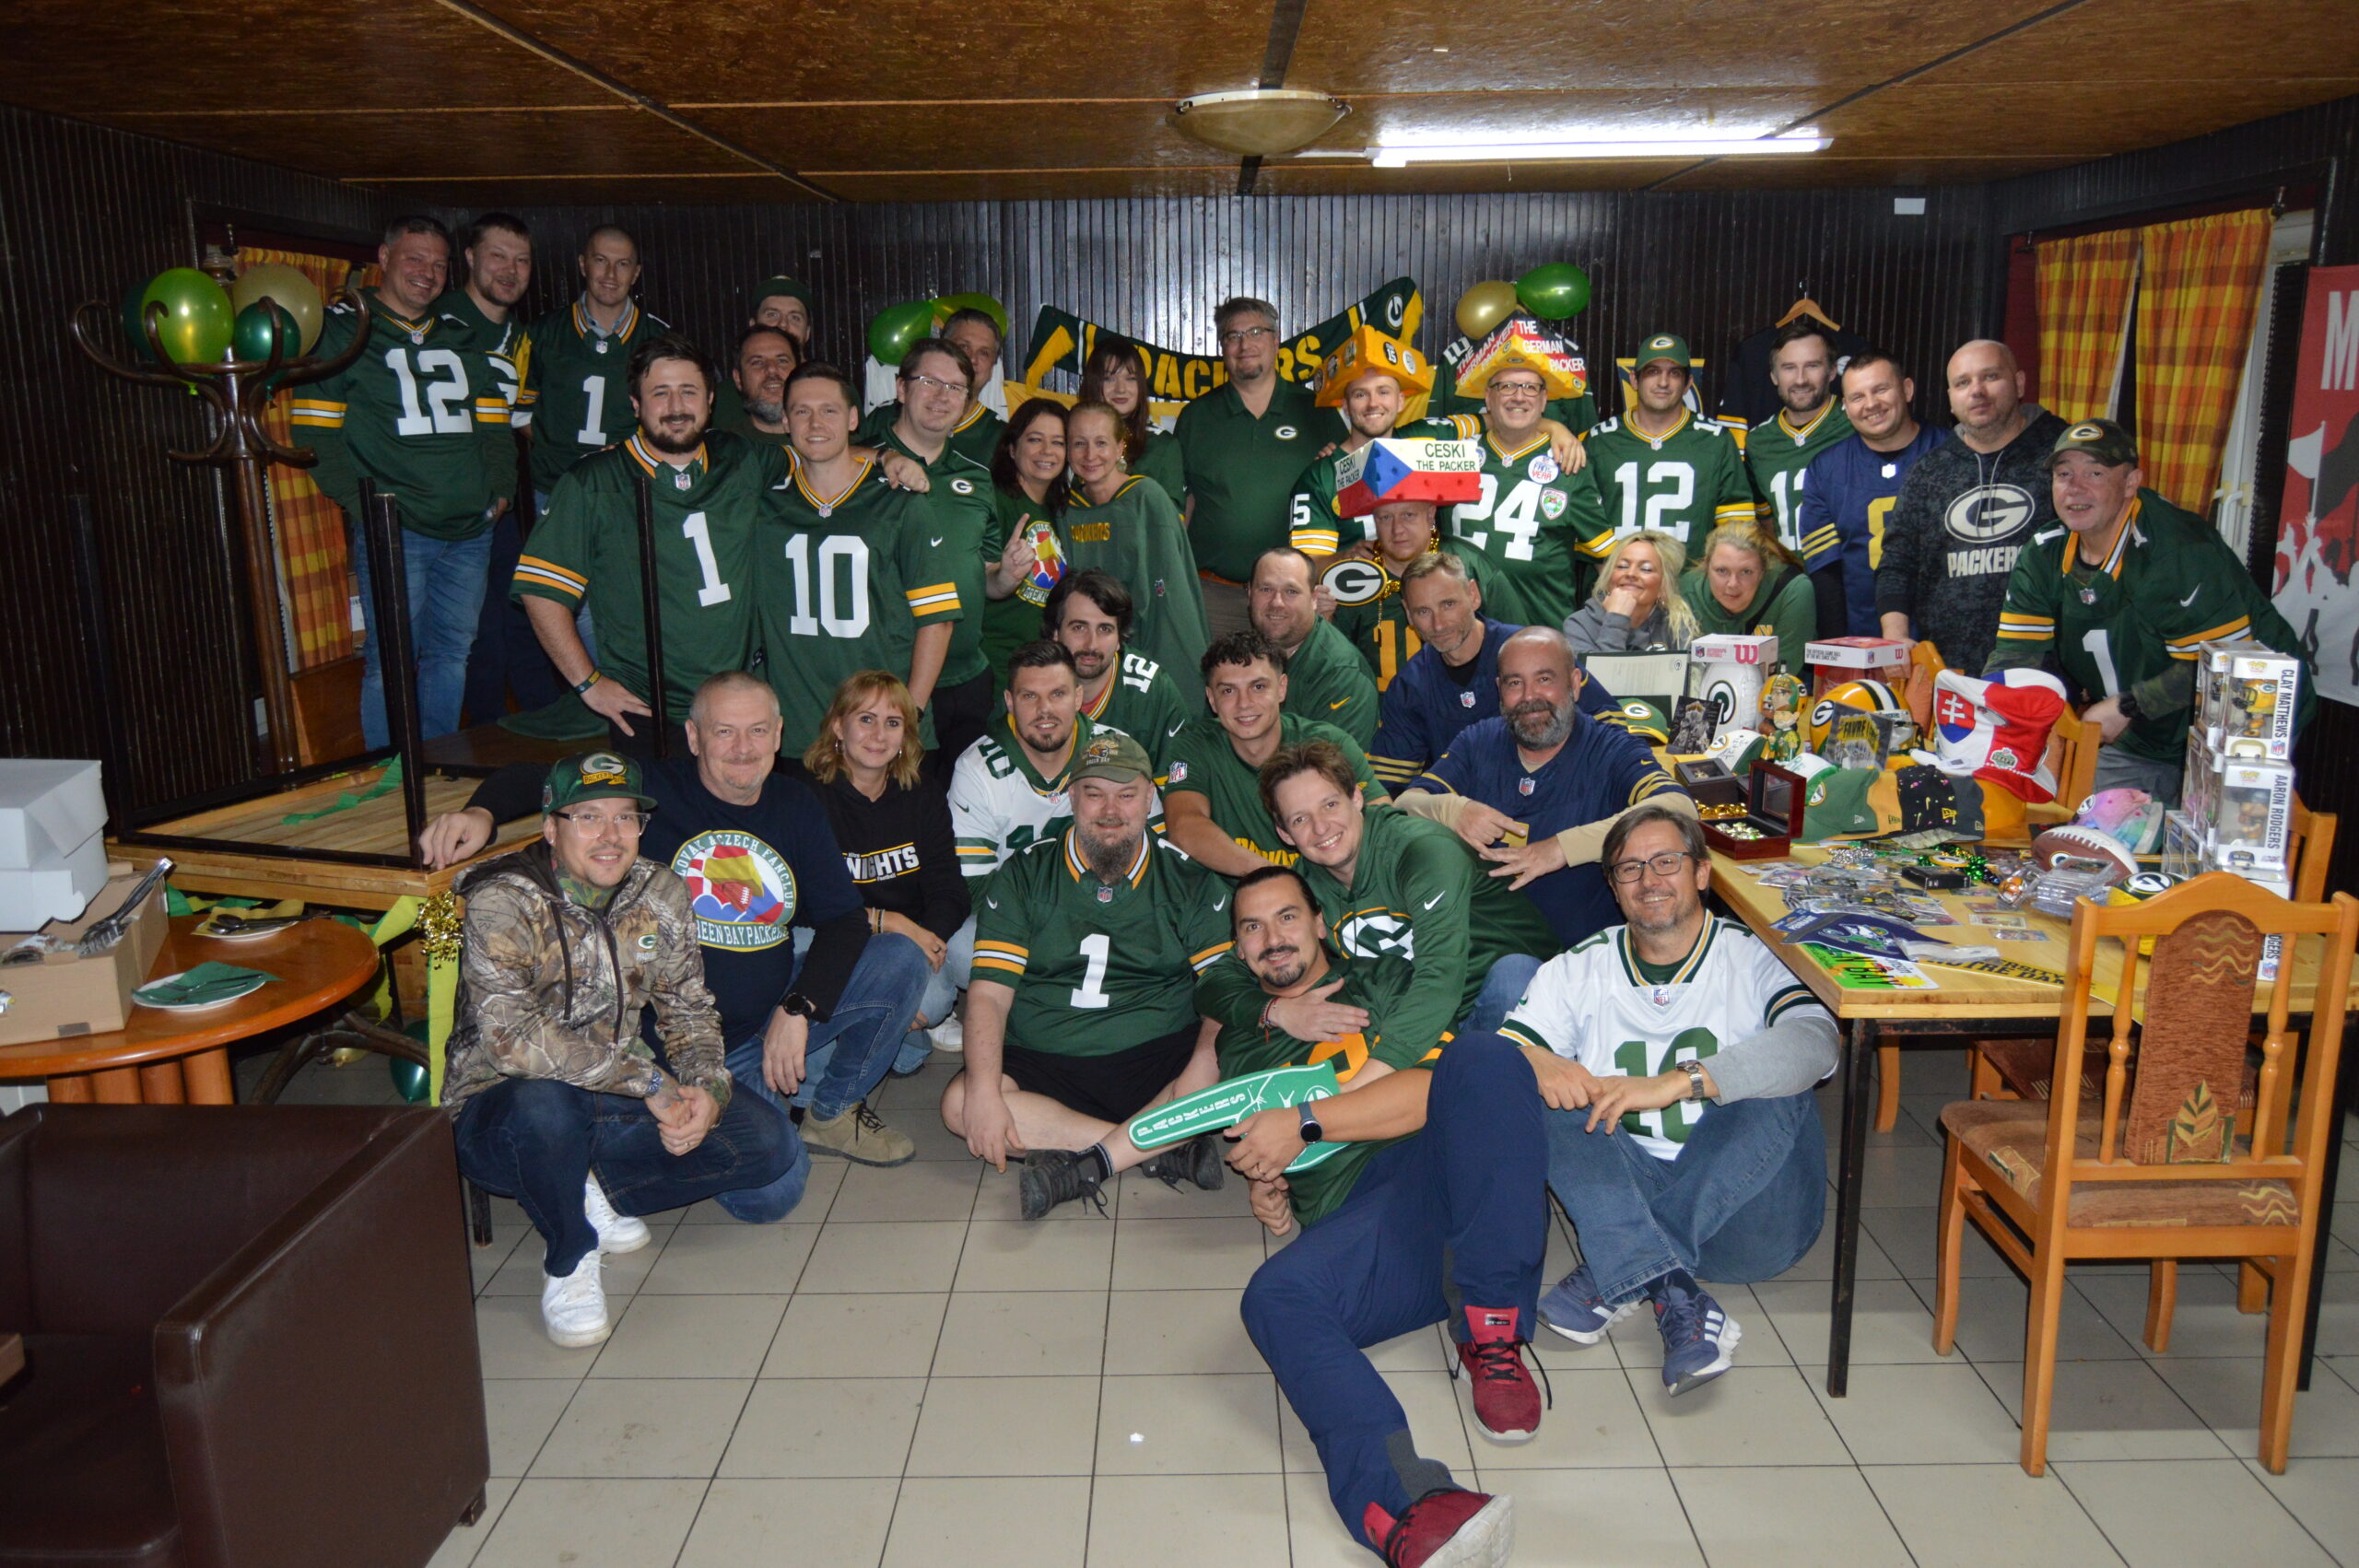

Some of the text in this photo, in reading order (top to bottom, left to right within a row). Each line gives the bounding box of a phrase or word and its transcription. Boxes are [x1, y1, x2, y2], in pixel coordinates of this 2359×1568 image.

[1481, 319, 1514, 371] PACKER
[1516, 320, 1538, 334] THE
[1522, 340, 1564, 354] GERMAN
[1549, 357, 1586, 373] PACKER
[385, 348, 473, 436] 12
[578, 375, 606, 445] 1
[1275, 426, 1297, 439] G
[1425, 443, 1465, 458] CESKI
[1339, 454, 1356, 474] CESKI
[1345, 469, 1360, 485] PACKER
[1416, 460, 1476, 472] THE PACKER
[951, 479, 973, 495] G
[1614, 462, 1695, 544] 12
[1291, 493, 1310, 525] 5
[1451, 473, 1543, 561] 24
[1946, 485, 2033, 541] G
[683, 511, 732, 607] 1
[785, 533, 870, 638] 10
[1322, 560, 1381, 604] G
[1123, 653, 1159, 693] 12
[2083, 629, 2118, 699] 1
[2274, 669, 2294, 738] CLAY MATTHEWS
[582, 753, 624, 774] G
[2272, 774, 2288, 805] AARON
[2267, 808, 2283, 849] RODGERS
[677, 839, 705, 876] LOVAK
[761, 849, 794, 909] FANCLUB
[846, 845, 920, 880] NIGHTS
[697, 920, 724, 943] EEN
[726, 926, 745, 945] BAY
[2267, 933, 2282, 959] DGERS
[1071, 934, 1109, 1009] 1
[1137, 1093, 1247, 1137] PACKERS
